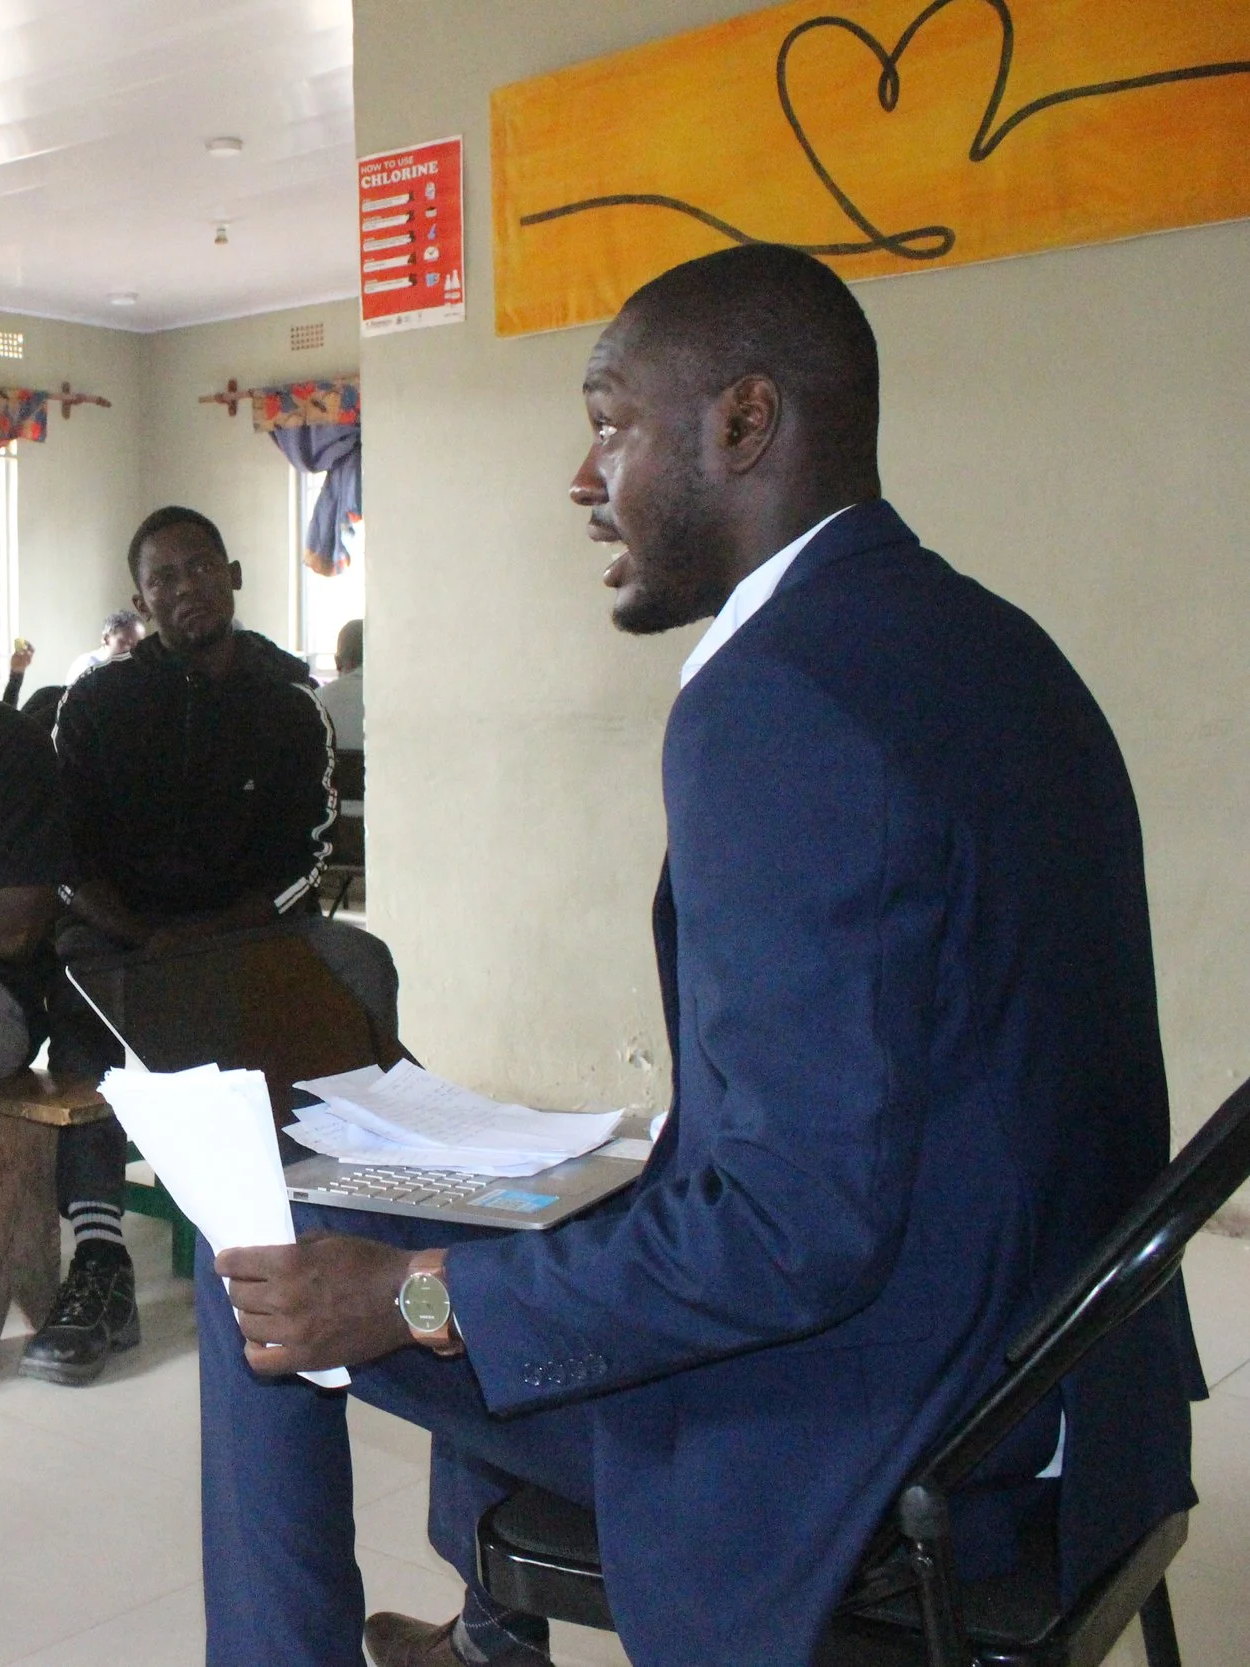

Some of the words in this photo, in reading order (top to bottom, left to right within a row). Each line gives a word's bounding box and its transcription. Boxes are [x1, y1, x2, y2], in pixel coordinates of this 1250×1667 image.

[361, 164, 382, 174] HOW
[384, 160, 396, 169] TO
[398, 155, 414, 166] USE
[361, 161, 439, 189] CHLORINE
